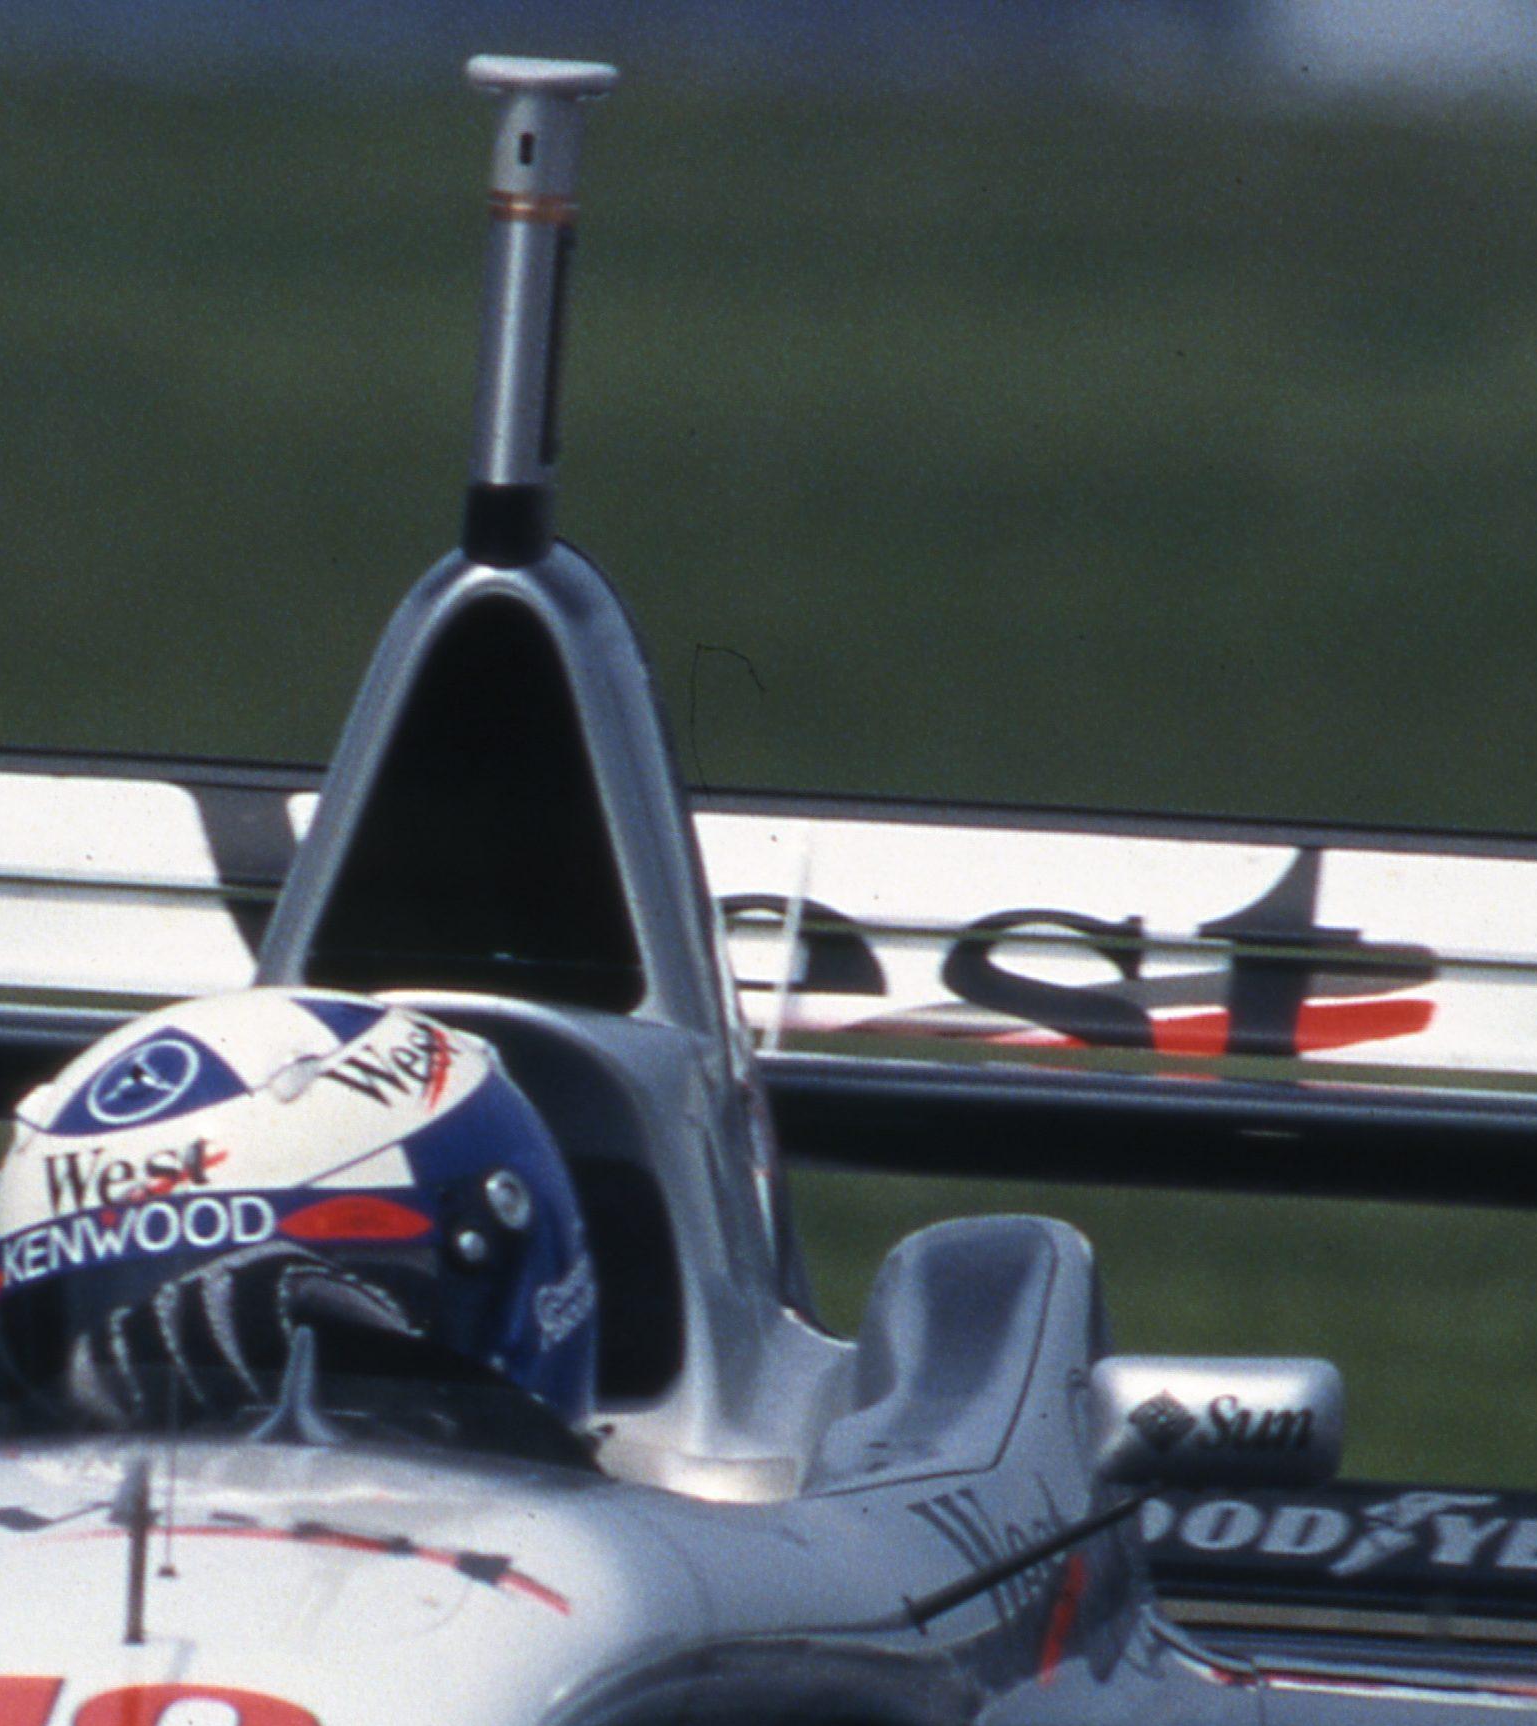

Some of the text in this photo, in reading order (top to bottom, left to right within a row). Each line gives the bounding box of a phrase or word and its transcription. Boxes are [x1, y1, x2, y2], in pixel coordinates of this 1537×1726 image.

[320, 1017, 463, 1112] West
[44, 1138, 227, 1216] West
[3, 1194, 275, 1287] KENWOOD
[1197, 1395, 1315, 1450] Sun
